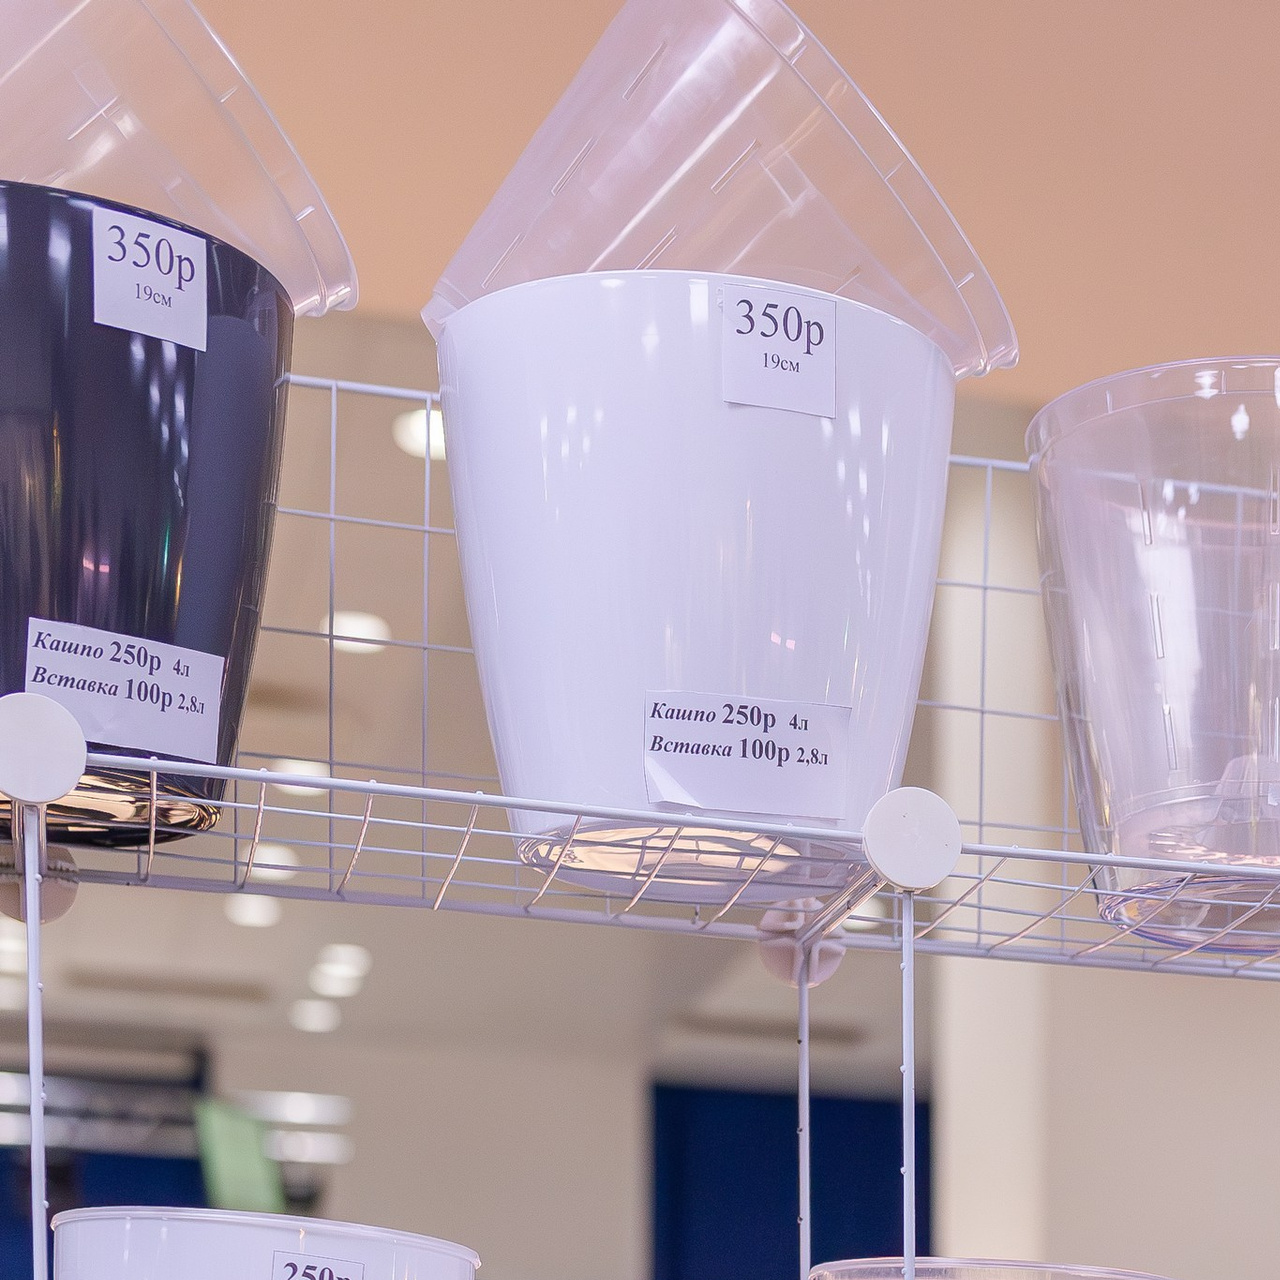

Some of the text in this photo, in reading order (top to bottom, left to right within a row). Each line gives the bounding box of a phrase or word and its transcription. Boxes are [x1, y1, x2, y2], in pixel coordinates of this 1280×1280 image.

[107, 225, 195, 292] 350р
[135, 283, 173, 308] 19см
[735, 299, 825, 356] 350р
[762, 352, 801, 374] 19см
[32, 630, 191, 679] Кашпо 250р 4л
[31, 664, 206, 715] Вставка 100р 2,8л
[649, 701, 809, 734] Кашпо 250р 4л
[649, 734, 829, 768] Вставка 100р 2,8л
